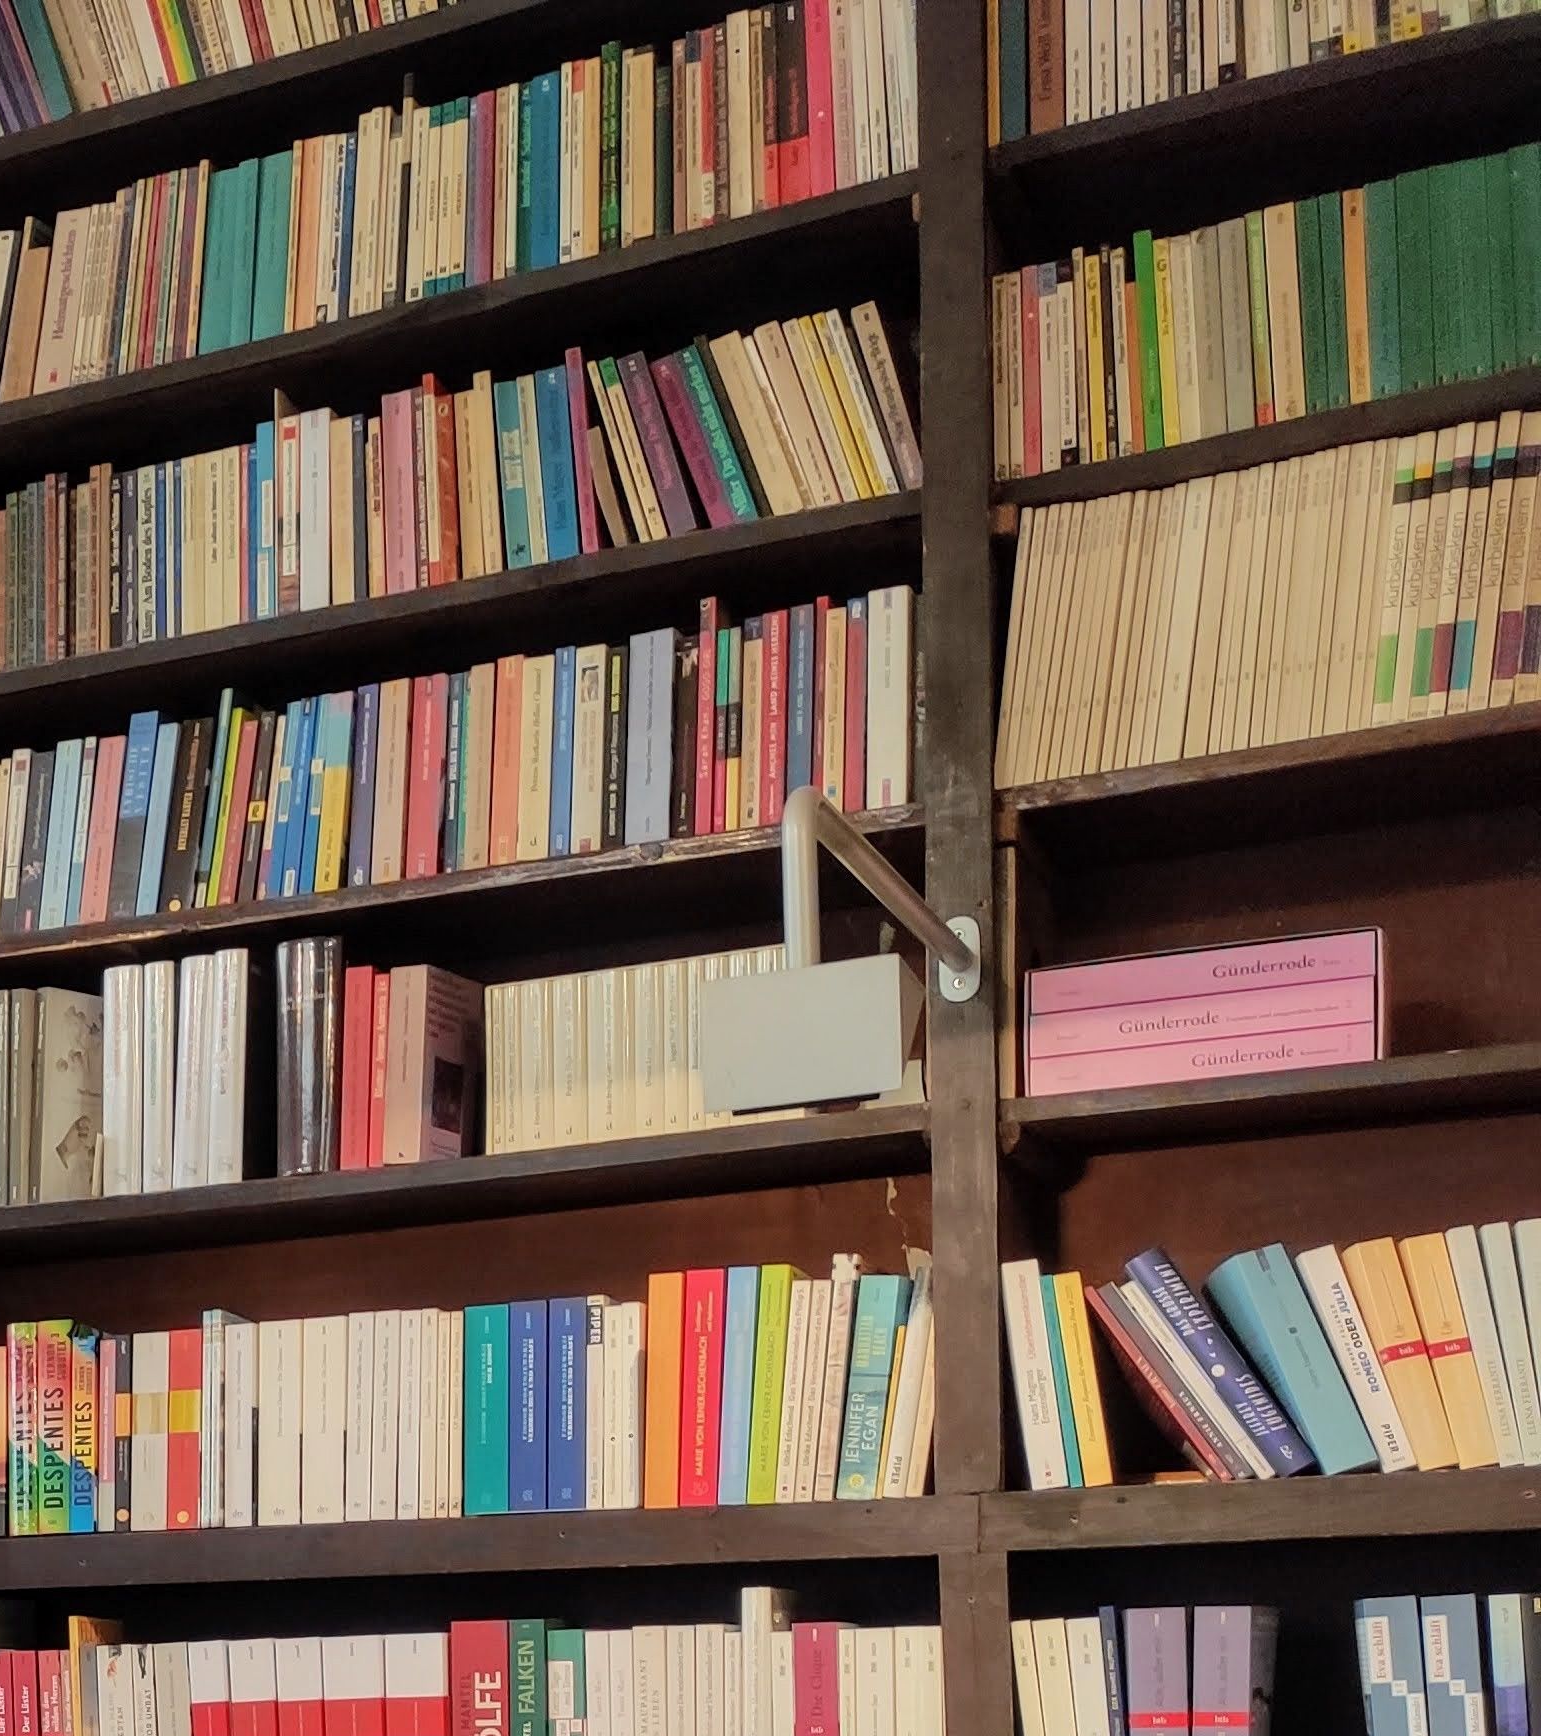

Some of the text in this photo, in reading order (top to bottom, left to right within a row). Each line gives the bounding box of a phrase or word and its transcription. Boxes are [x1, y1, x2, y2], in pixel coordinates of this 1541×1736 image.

[1211, 953, 1317, 979] Günderrode
[1118, 1009, 1220, 1036] Günderrode
[1190, 1043, 1295, 1069] Günderrode
[590, 1306, 602, 1344] PIPER
[1154, 1261, 1218, 1333] EXPERIMENT
[1330, 1280, 1380, 1394] JULIA ODER ROMEO
[43, 1387, 65, 1511] DESPENTES
[73, 1402, 93, 1508] DESPENTES
[844, 1392, 866, 1462] JENNIFER
[862, 1401, 879, 1452] EGAN
[1380, 1422, 1399, 1453] PIPER
[517, 1638, 536, 1716] FALKEN
[1371, 1619, 1388, 1679] Eva schläft
[1429, 1619, 1446, 1679] Eva schläft
[19, 1684, 31, 1734] Der Lüster
